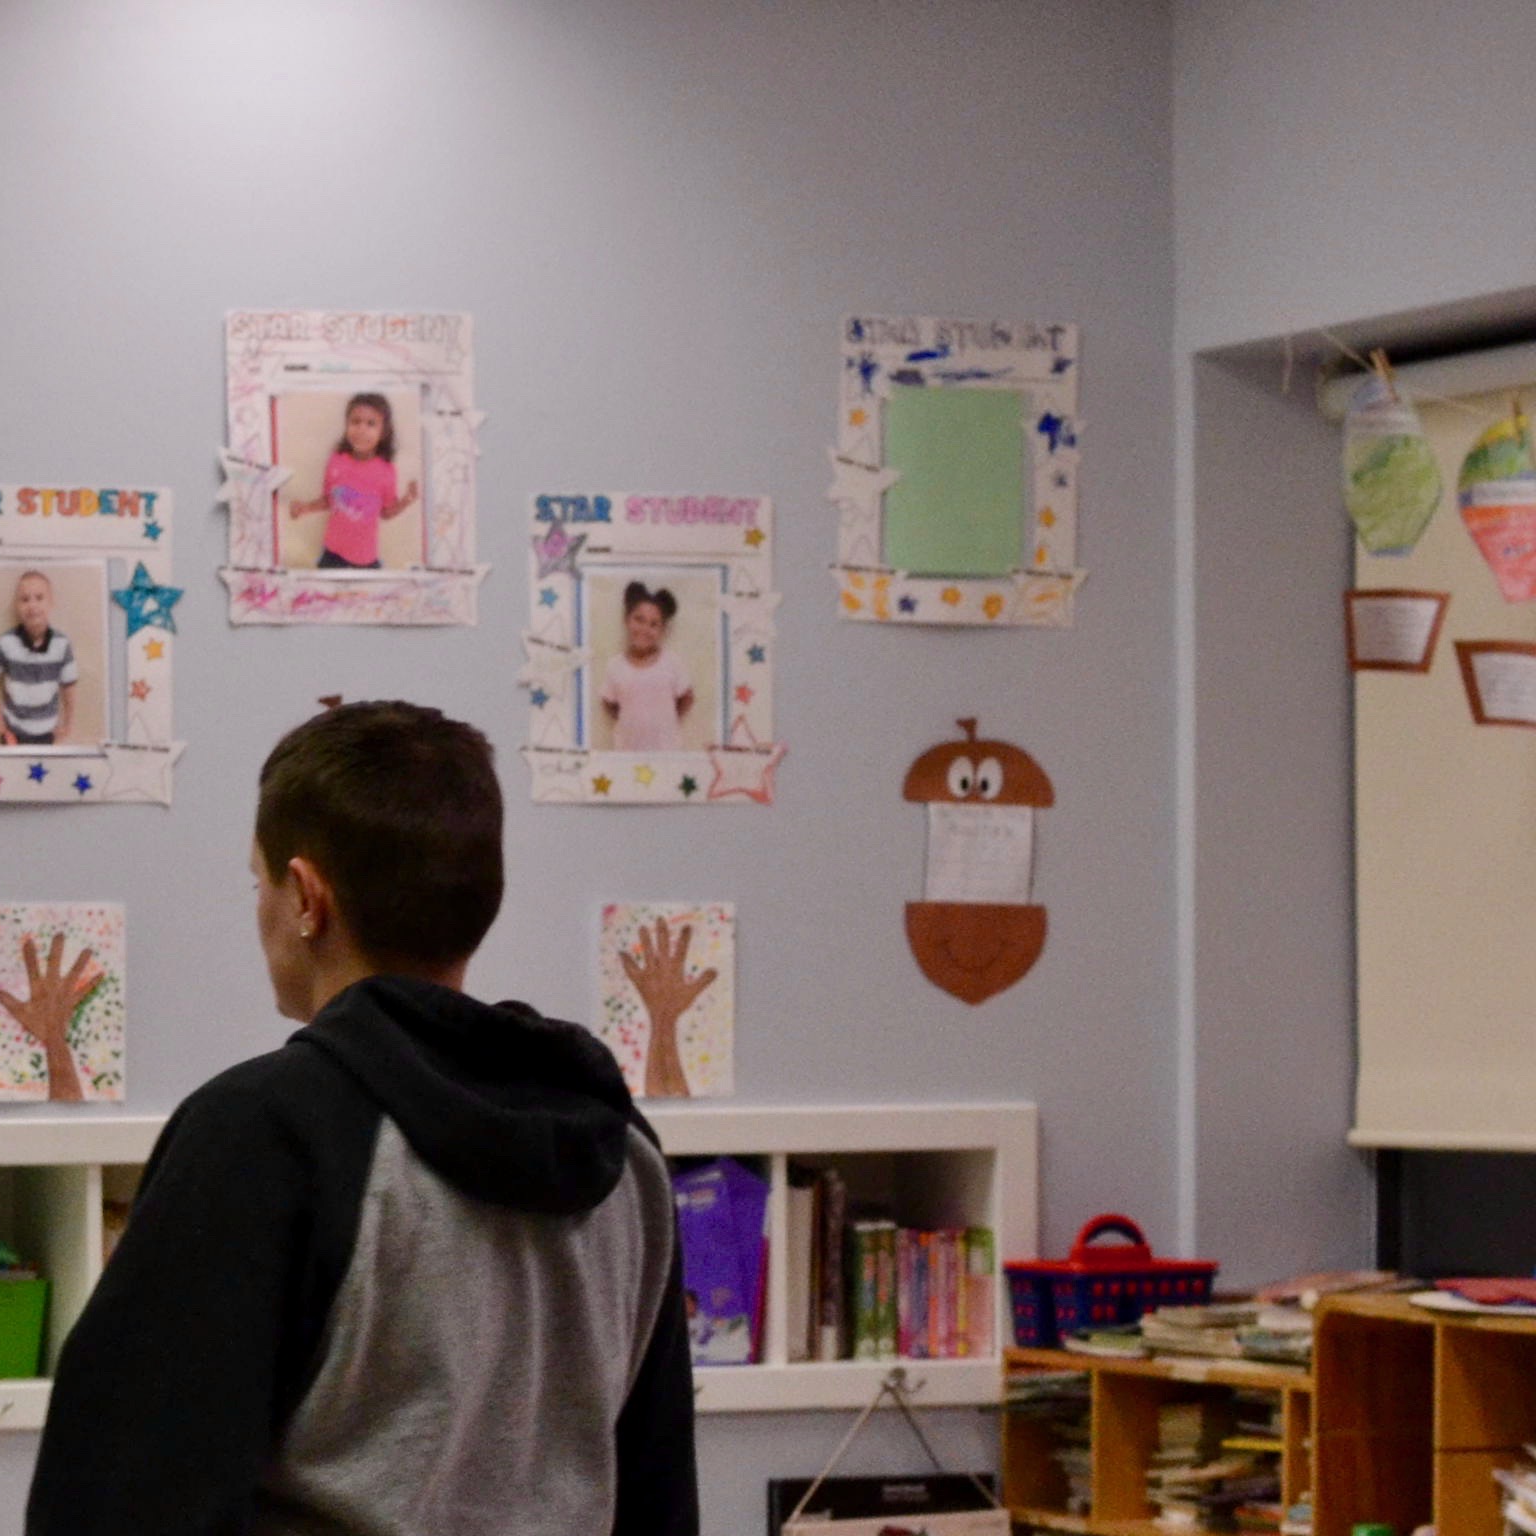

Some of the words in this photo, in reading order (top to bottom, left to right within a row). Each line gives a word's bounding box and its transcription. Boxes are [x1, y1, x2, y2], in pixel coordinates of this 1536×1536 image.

[229, 311, 311, 340] STAR
[16, 487, 159, 517] STUDENT
[535, 494, 613, 523] STAR
[625, 494, 761, 525] STUDENT
